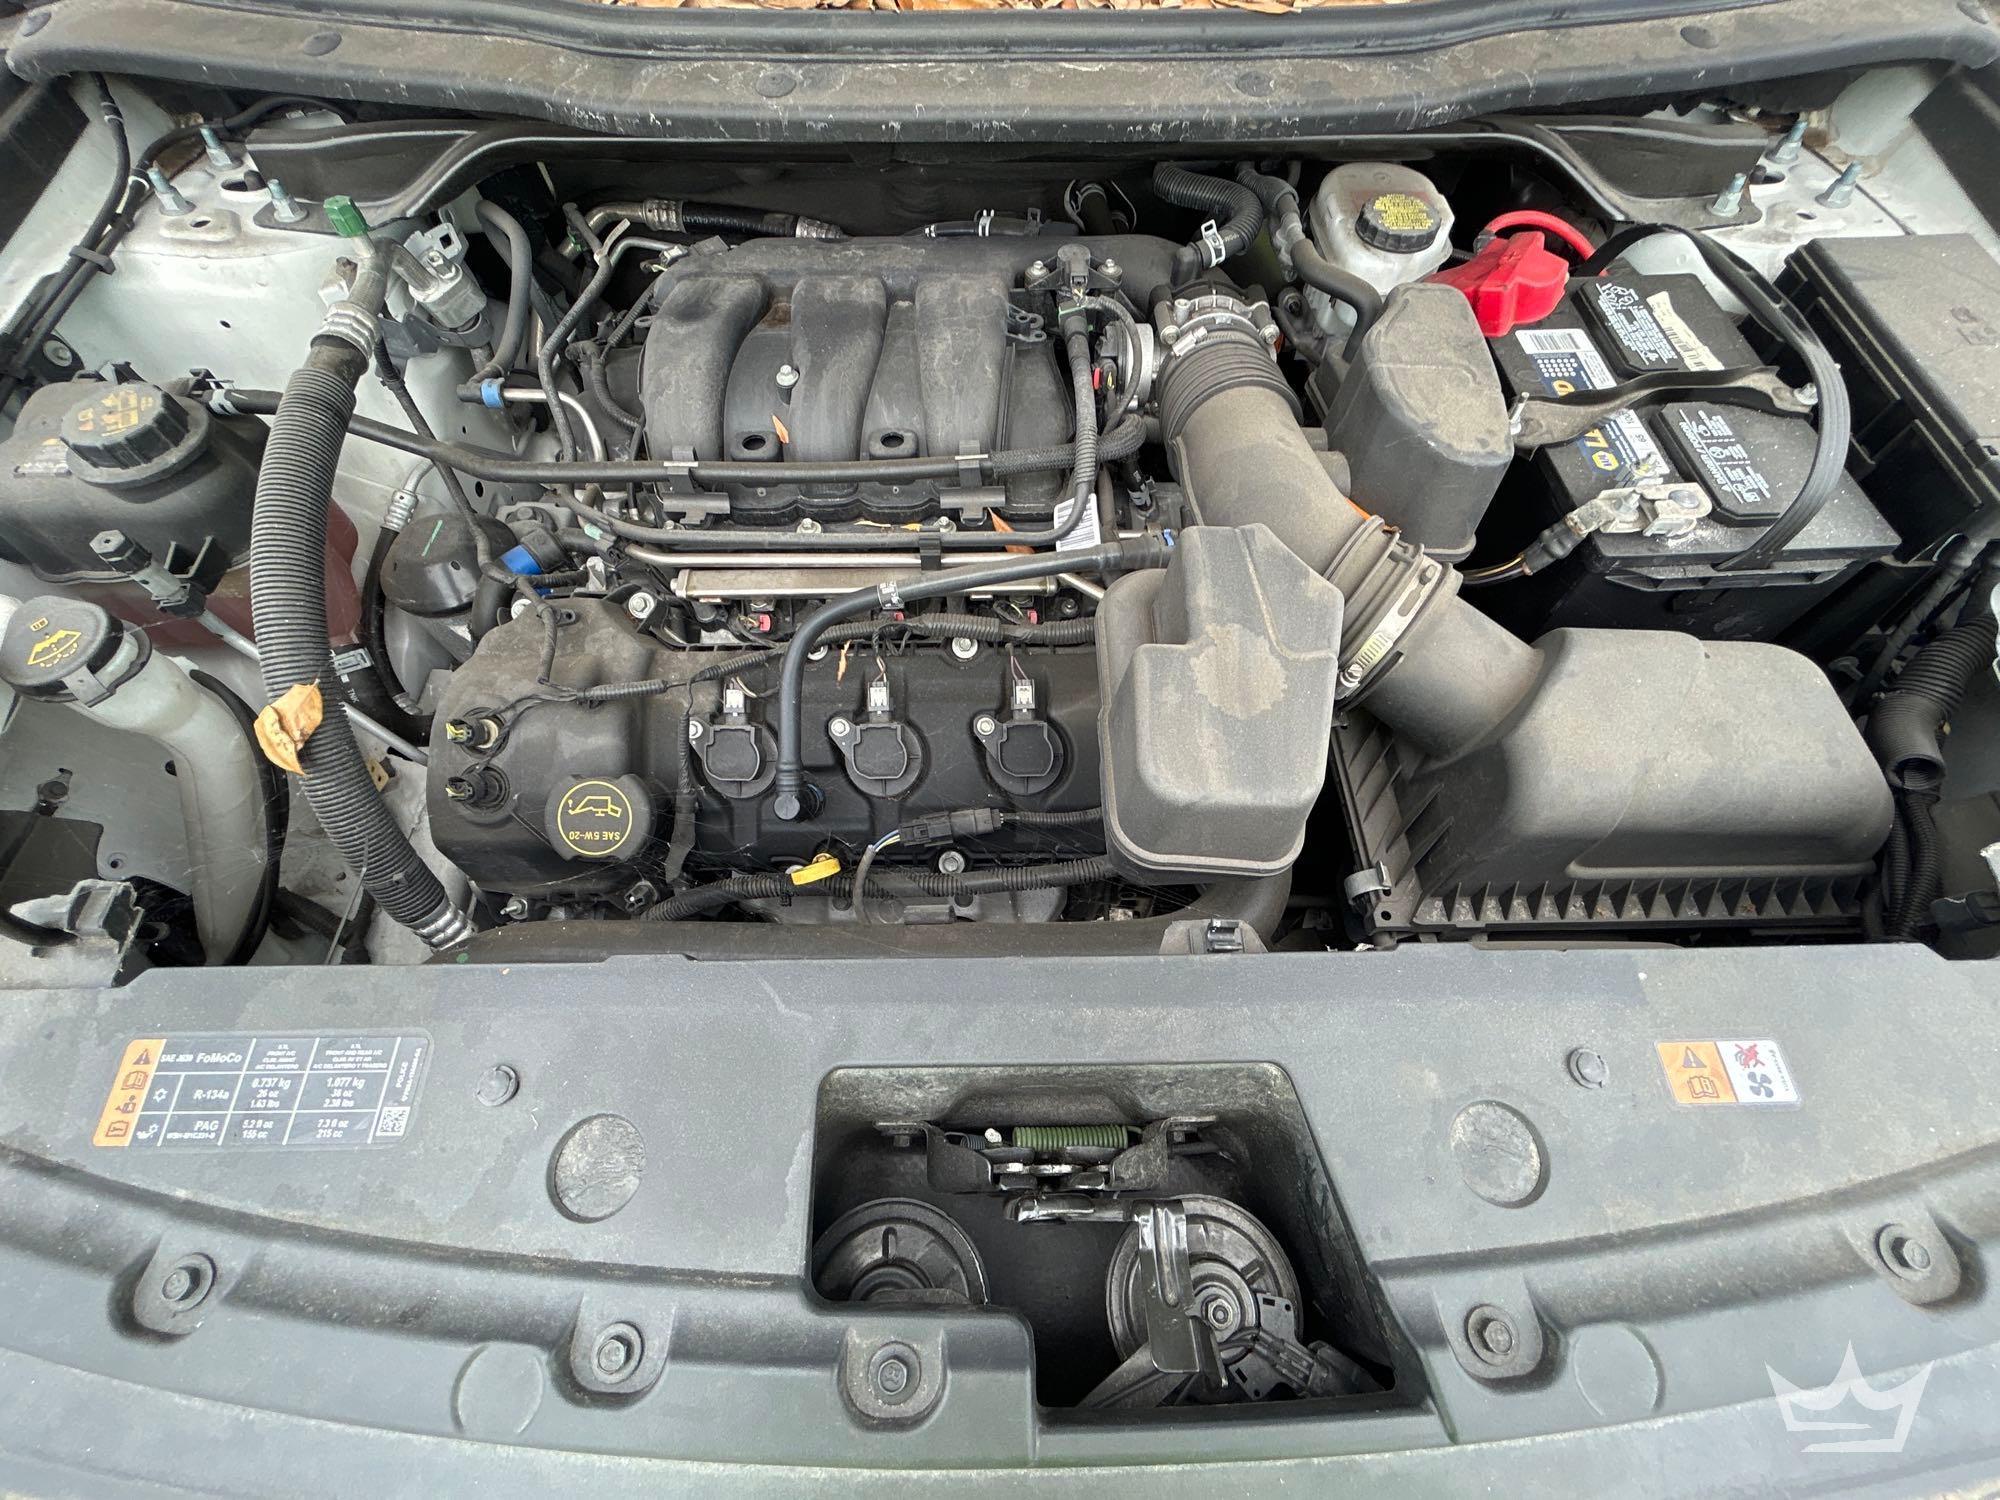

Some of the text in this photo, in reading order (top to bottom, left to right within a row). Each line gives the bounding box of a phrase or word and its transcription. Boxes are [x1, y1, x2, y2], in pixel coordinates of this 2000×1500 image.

[1679, 420, 1703, 449] POISON
[1701, 453, 1727, 485] DANGER
[568, 830, 620, 840] SAE 5W-20
[160, 1053, 177, 1063] SAE
[196, 1052, 243, 1064] FoMoCo
[395, 1061, 408, 1088] POLICE
[251, 1077, 292, 1090] 0.737 kg
[326, 1076, 366, 1090] 1.077 kg
[193, 1088, 230, 1100] R-134a
[269, 1089, 280, 1098] oz
[342, 1089, 354, 1098] oz
[250, 1099, 280, 1109] 1.63 lbs
[341, 1098, 355, 1108] lbs
[193, 1120, 219, 1131] PAG
[242, 1119, 256, 1129] 5.2
[263, 1120, 274, 1129] oz
[317, 1118, 331, 1128] 7.3
[338, 1119, 350, 1128] oz
[242, 1129, 269, 1139] 155 cc
[316, 1128, 344, 1139] 215 cc
